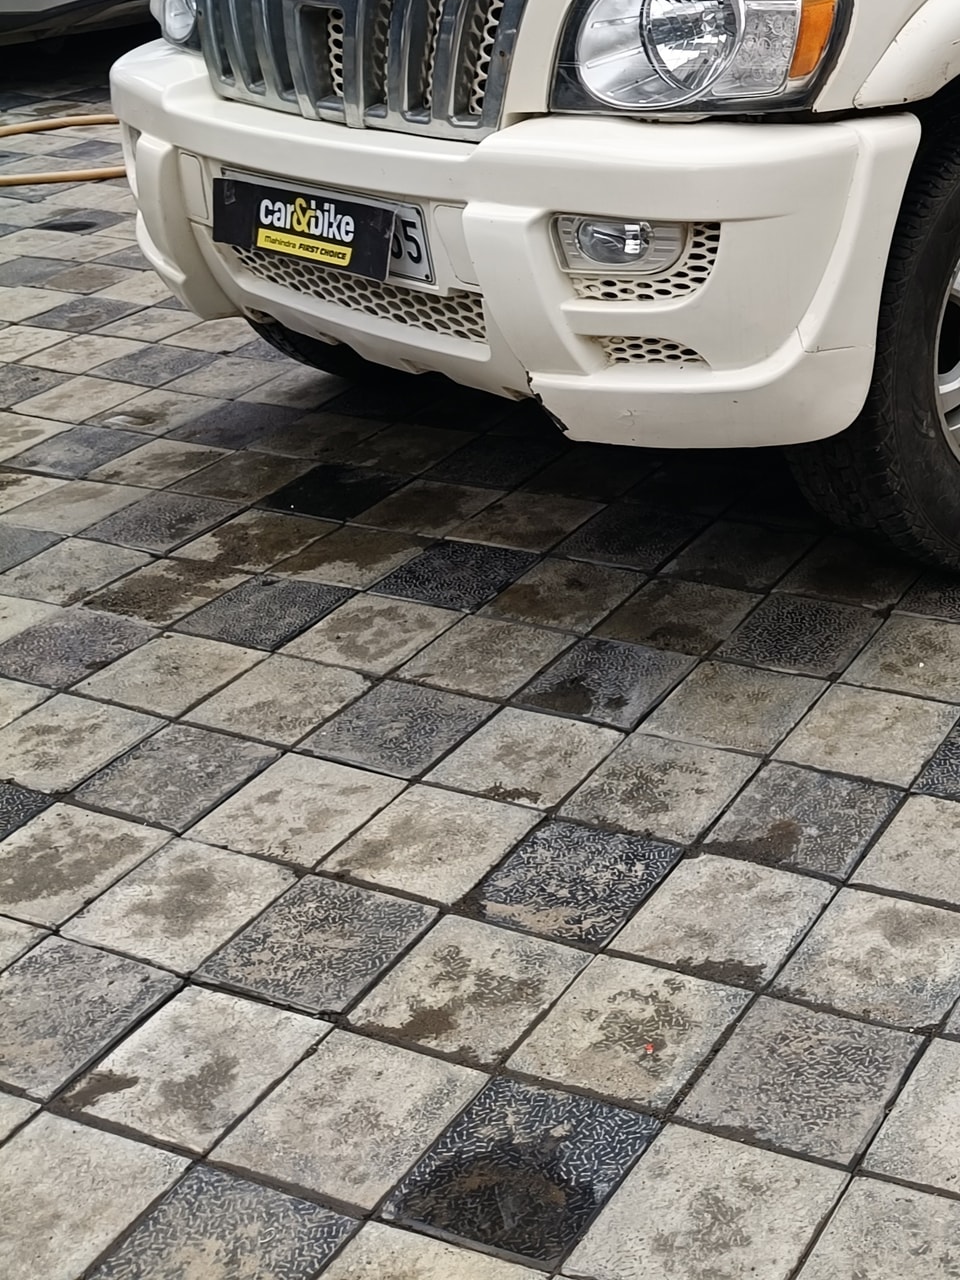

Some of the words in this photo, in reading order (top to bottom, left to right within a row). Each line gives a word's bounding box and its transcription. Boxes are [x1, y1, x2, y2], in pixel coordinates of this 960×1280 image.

[260, 198, 354, 242] car&bike
[264, 235, 296, 249] Mahindra
[298, 243, 319, 254] FIRST
[320, 248, 347, 260] CHOICE
